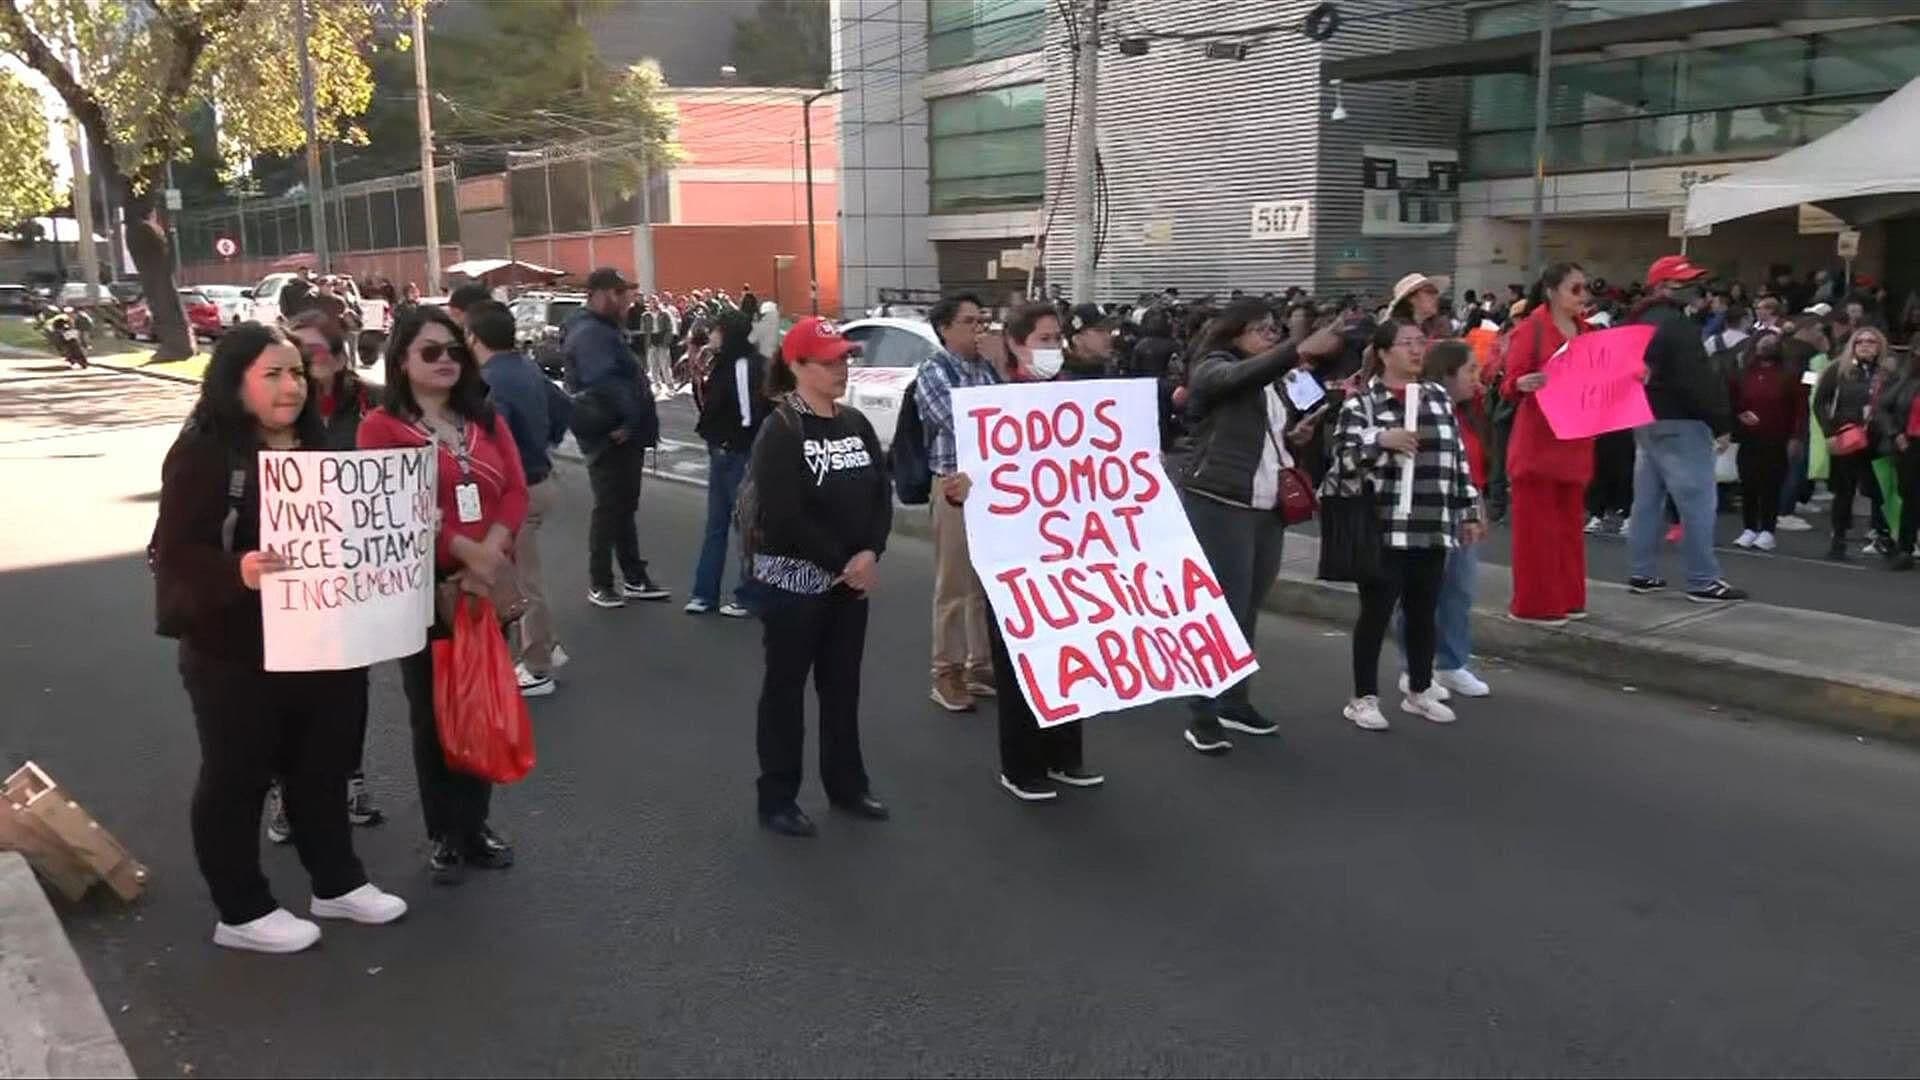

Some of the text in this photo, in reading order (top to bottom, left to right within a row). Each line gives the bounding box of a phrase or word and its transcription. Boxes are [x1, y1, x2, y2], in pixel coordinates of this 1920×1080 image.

[1258, 206, 1303, 231] 507
[969, 400, 1122, 460] TODOS
[265, 457, 302, 492] NO
[988, 452, 1160, 514] SOMOS
[266, 500, 342, 533] VIVIR
[352, 494, 405, 530] DEL
[1039, 506, 1144, 562] SAT
[1019, 614, 1257, 721] LABORAL
